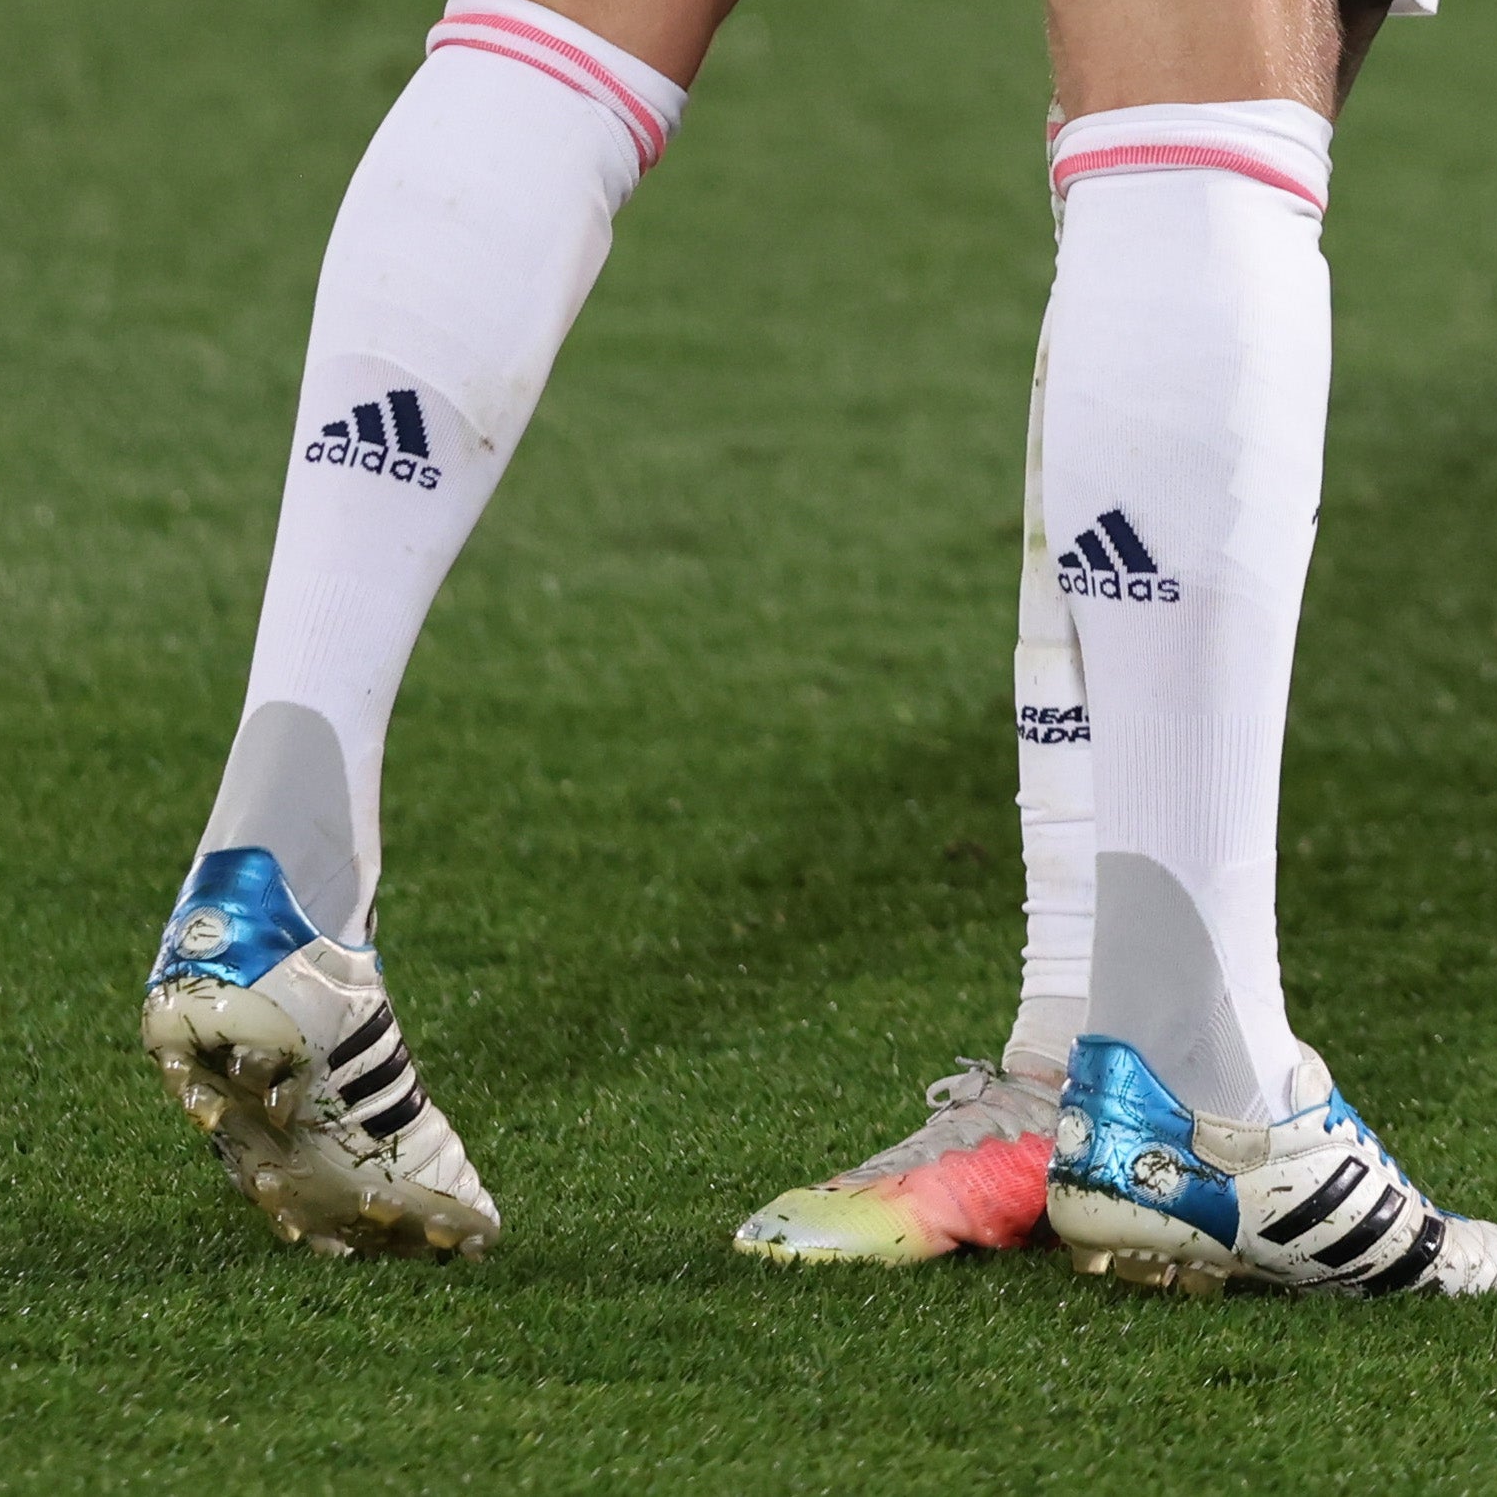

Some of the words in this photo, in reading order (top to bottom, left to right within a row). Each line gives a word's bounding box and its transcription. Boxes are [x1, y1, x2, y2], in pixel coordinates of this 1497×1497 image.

[305, 437, 442, 490] adidas
[1058, 569, 1180, 603] adidas
[1016, 723, 1090, 744] MADR
